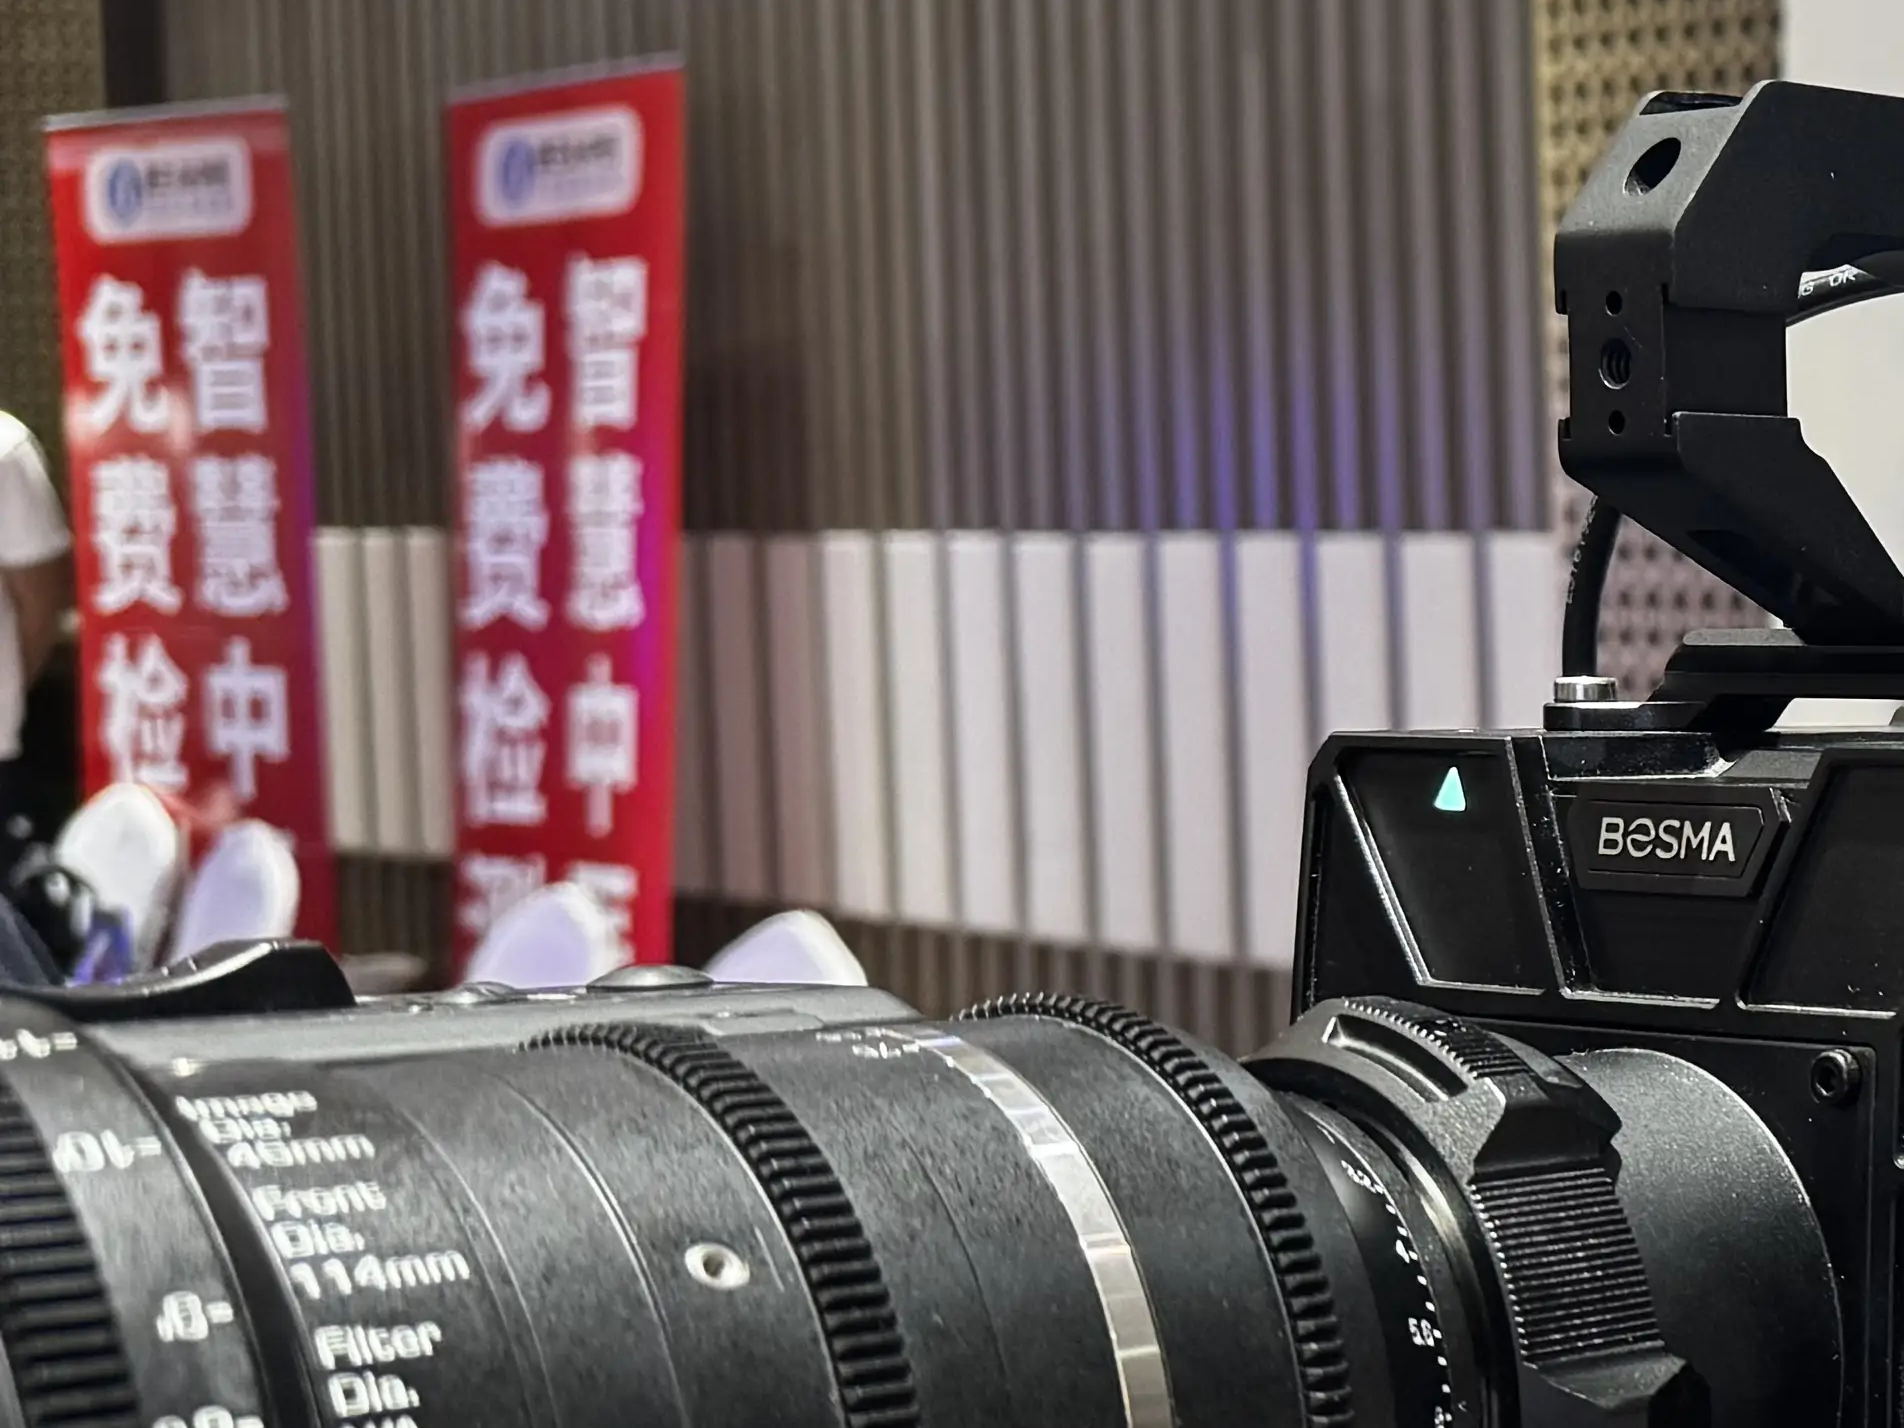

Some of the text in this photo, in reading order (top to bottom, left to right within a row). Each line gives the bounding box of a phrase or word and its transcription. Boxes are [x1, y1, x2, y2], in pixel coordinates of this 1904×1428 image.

[1598, 817, 1736, 863] BOSMA
[252, 1180, 387, 1221] Front
[271, 1218, 366, 1260] Dia.
[290, 1249, 471, 1300] 114mm
[314, 1319, 443, 1370] Filter
[328, 1369, 421, 1418] Dia.
